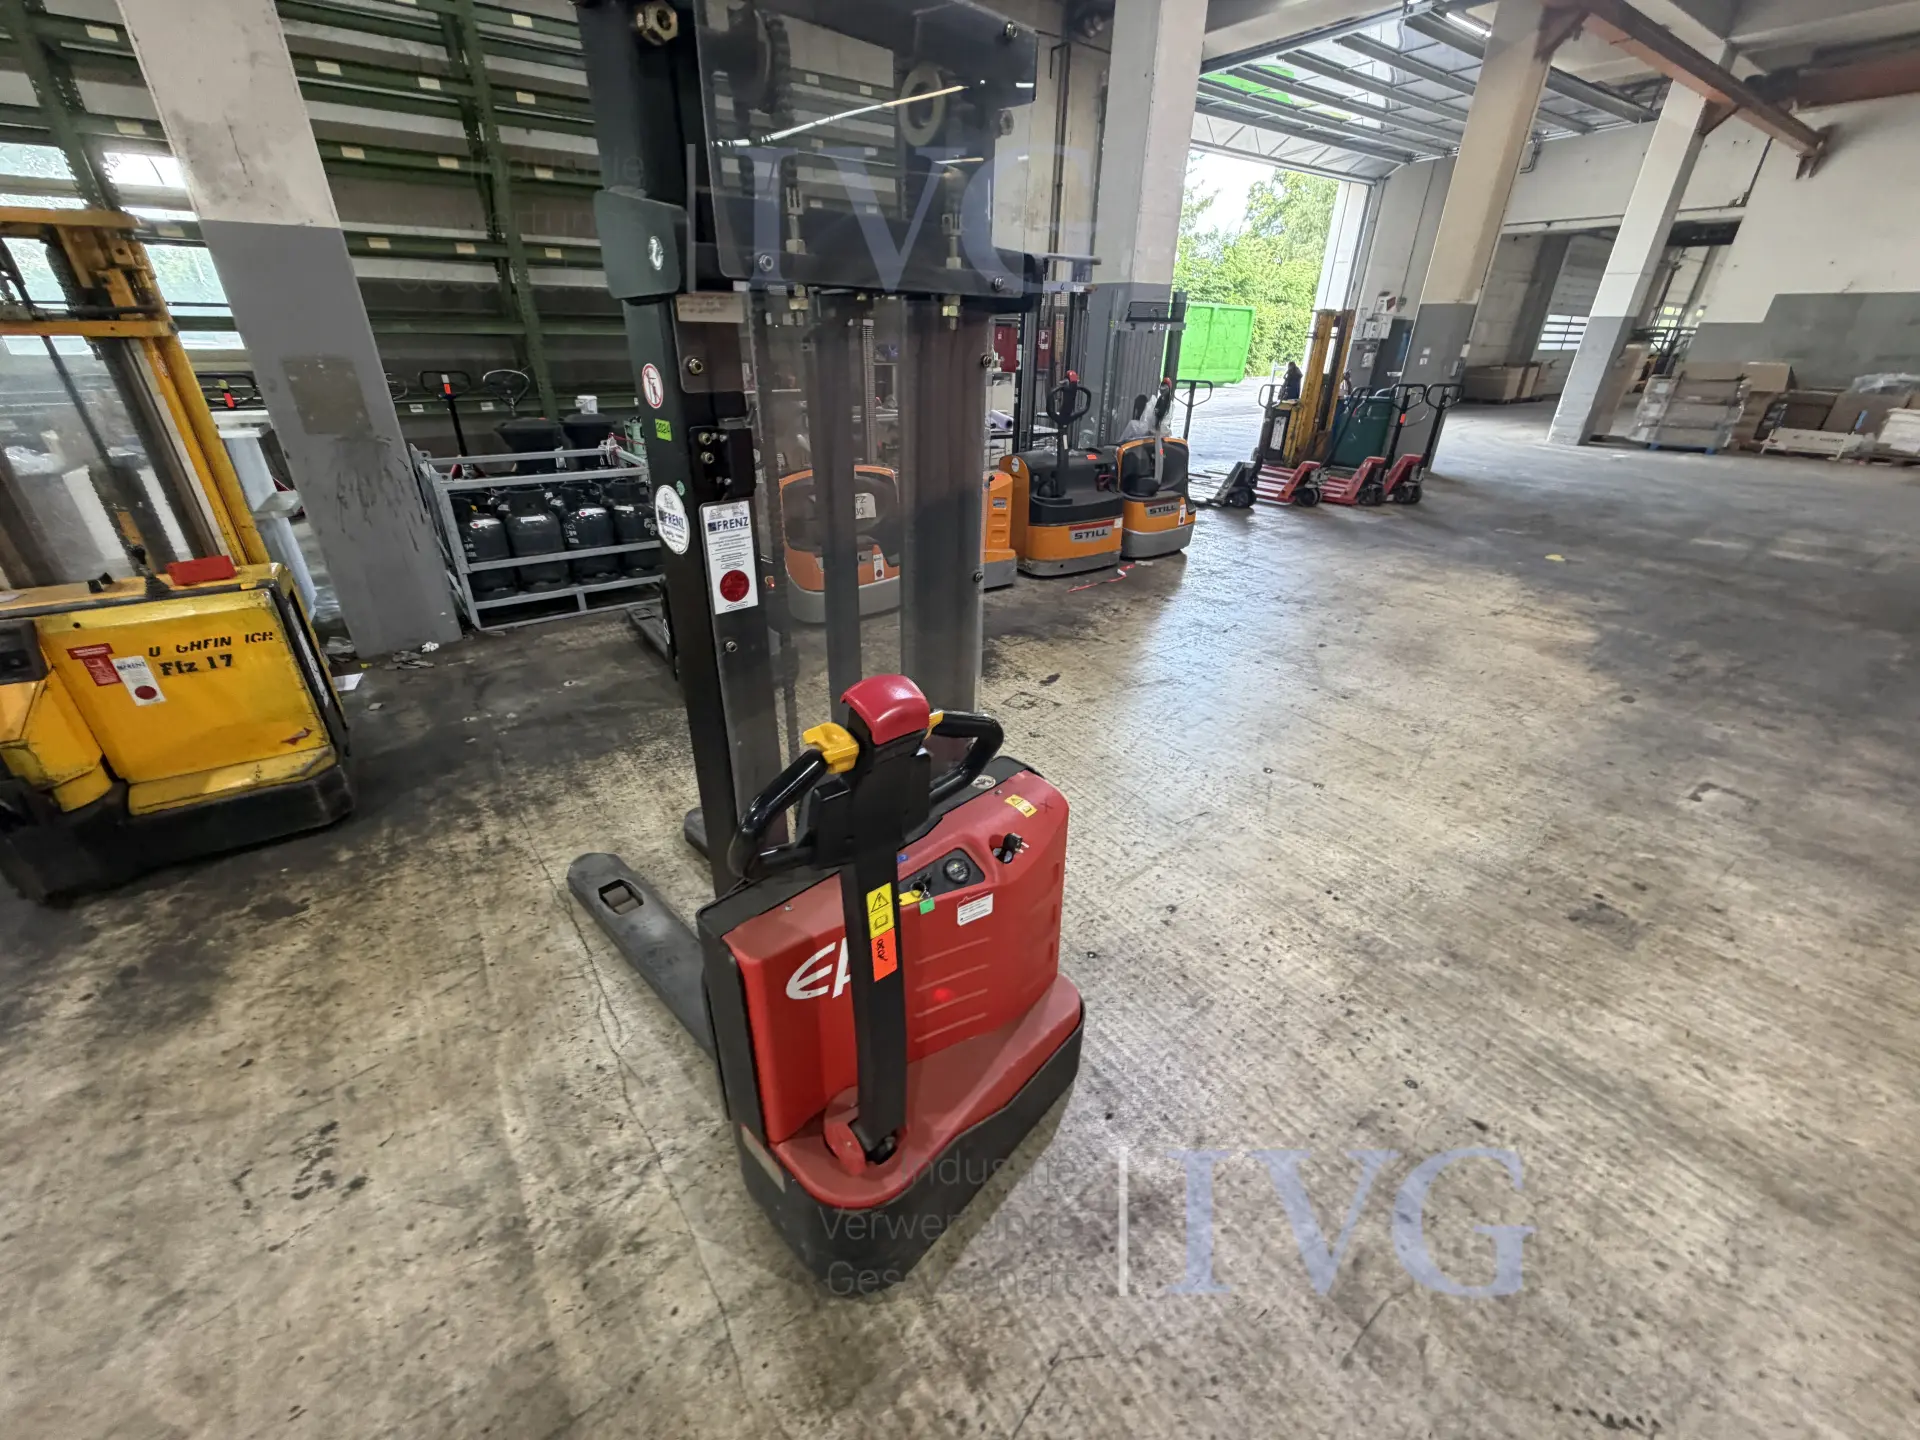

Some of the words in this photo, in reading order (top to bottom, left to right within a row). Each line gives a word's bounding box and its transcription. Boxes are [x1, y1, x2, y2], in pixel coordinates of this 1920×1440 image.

[1150, 504, 1176, 515] STILL
[717, 516, 749, 531] FRENZ
[1074, 529, 1109, 540] STILL
[206, 654, 233, 669] 17
